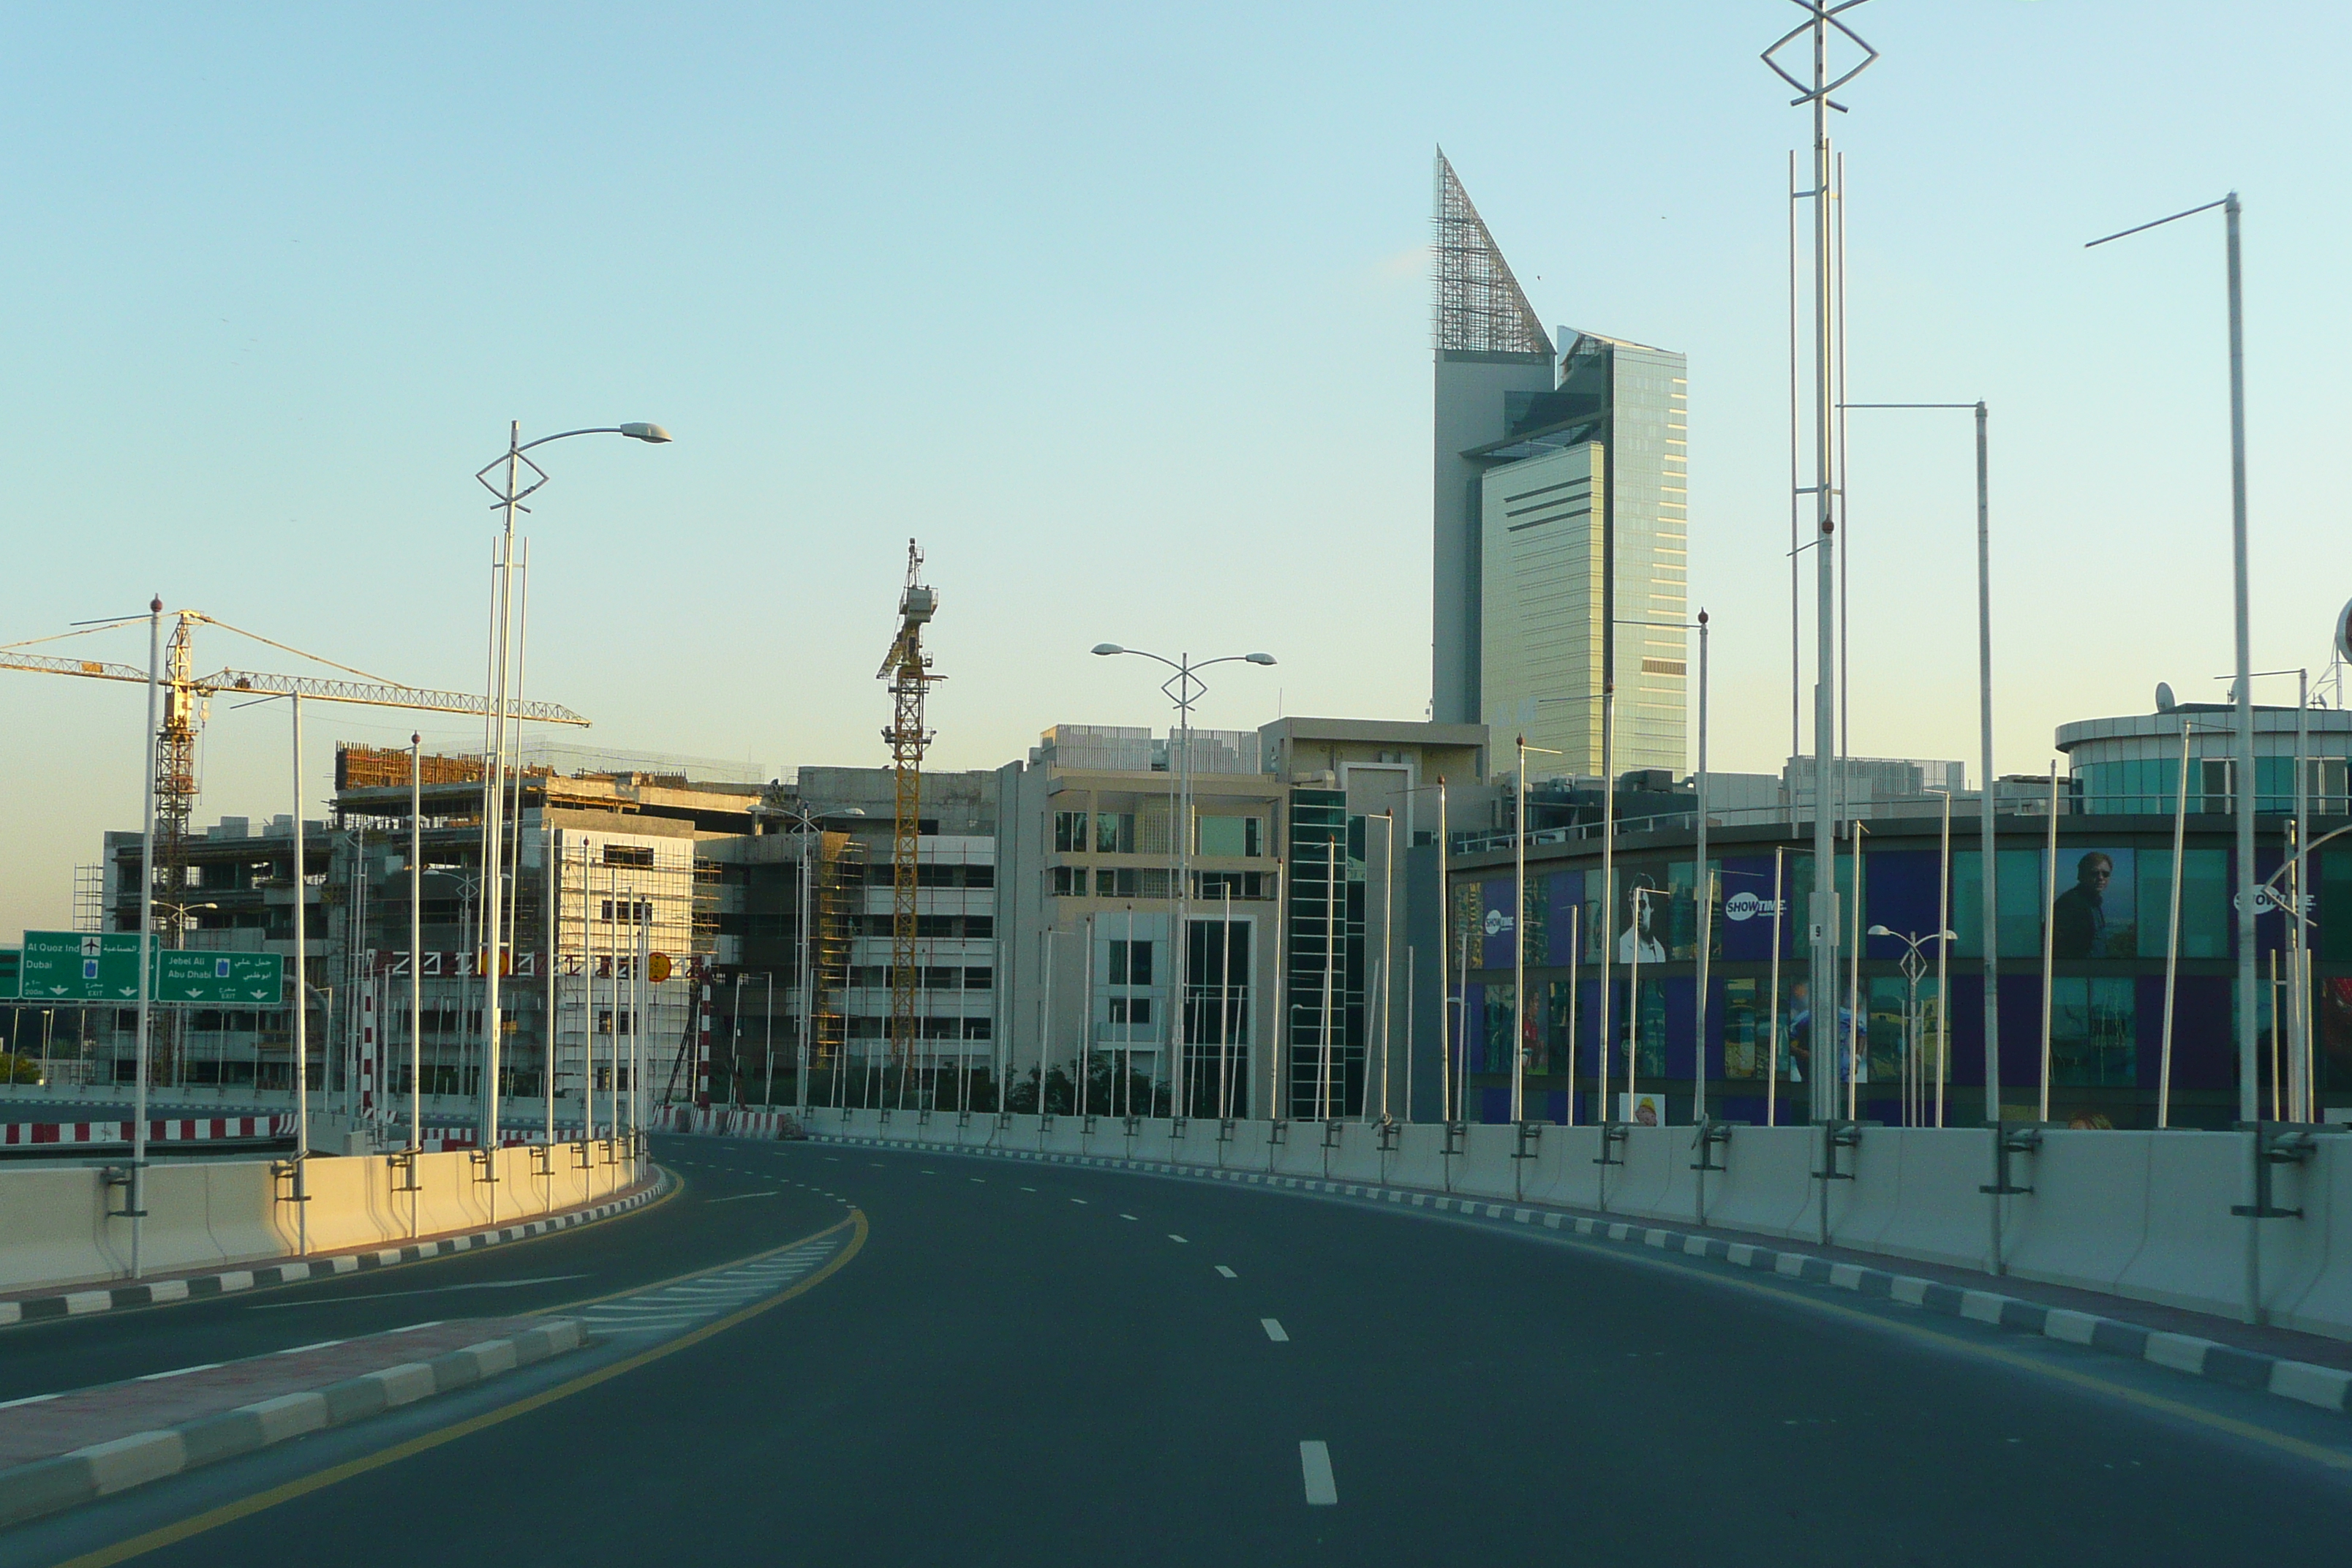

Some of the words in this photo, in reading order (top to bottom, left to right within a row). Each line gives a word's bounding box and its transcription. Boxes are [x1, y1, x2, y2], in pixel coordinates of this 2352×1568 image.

[1727, 900, 1787, 913] SHOWTIME
[1815, 925, 1821, 937] 9
[28, 943, 37, 951] Al
[39, 943, 63, 952] Quoz
[65, 944, 80, 952] Ind
[103, 944, 136, 953] الصناعية
[26, 960, 53, 969] Dubai
[168, 957, 192, 965] Jebel
[193, 957, 205, 965] Ali
[234, 958, 251, 968] علي
[255, 958, 272, 967] جبل
[167, 970, 185, 979] Abu
[186, 970, 211, 979] Dhabi
